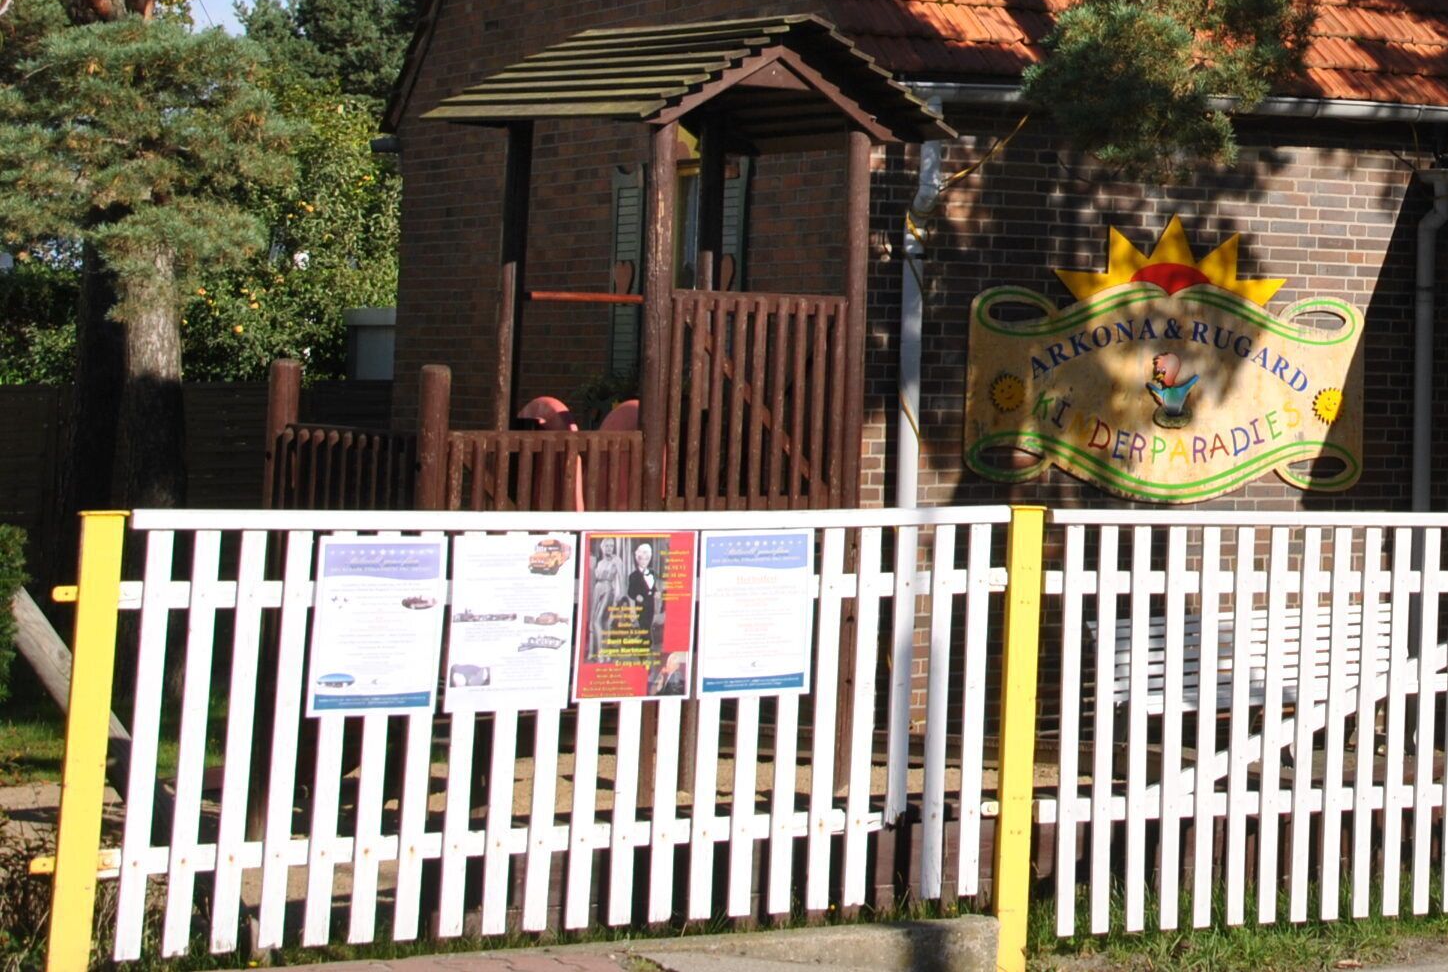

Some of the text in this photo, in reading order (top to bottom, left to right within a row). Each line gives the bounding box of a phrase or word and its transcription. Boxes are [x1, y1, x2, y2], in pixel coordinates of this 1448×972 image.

[1031, 318, 1308, 392] ARKONA & RUGARD
[1031, 390, 1301, 465] KINDERPARADIES
